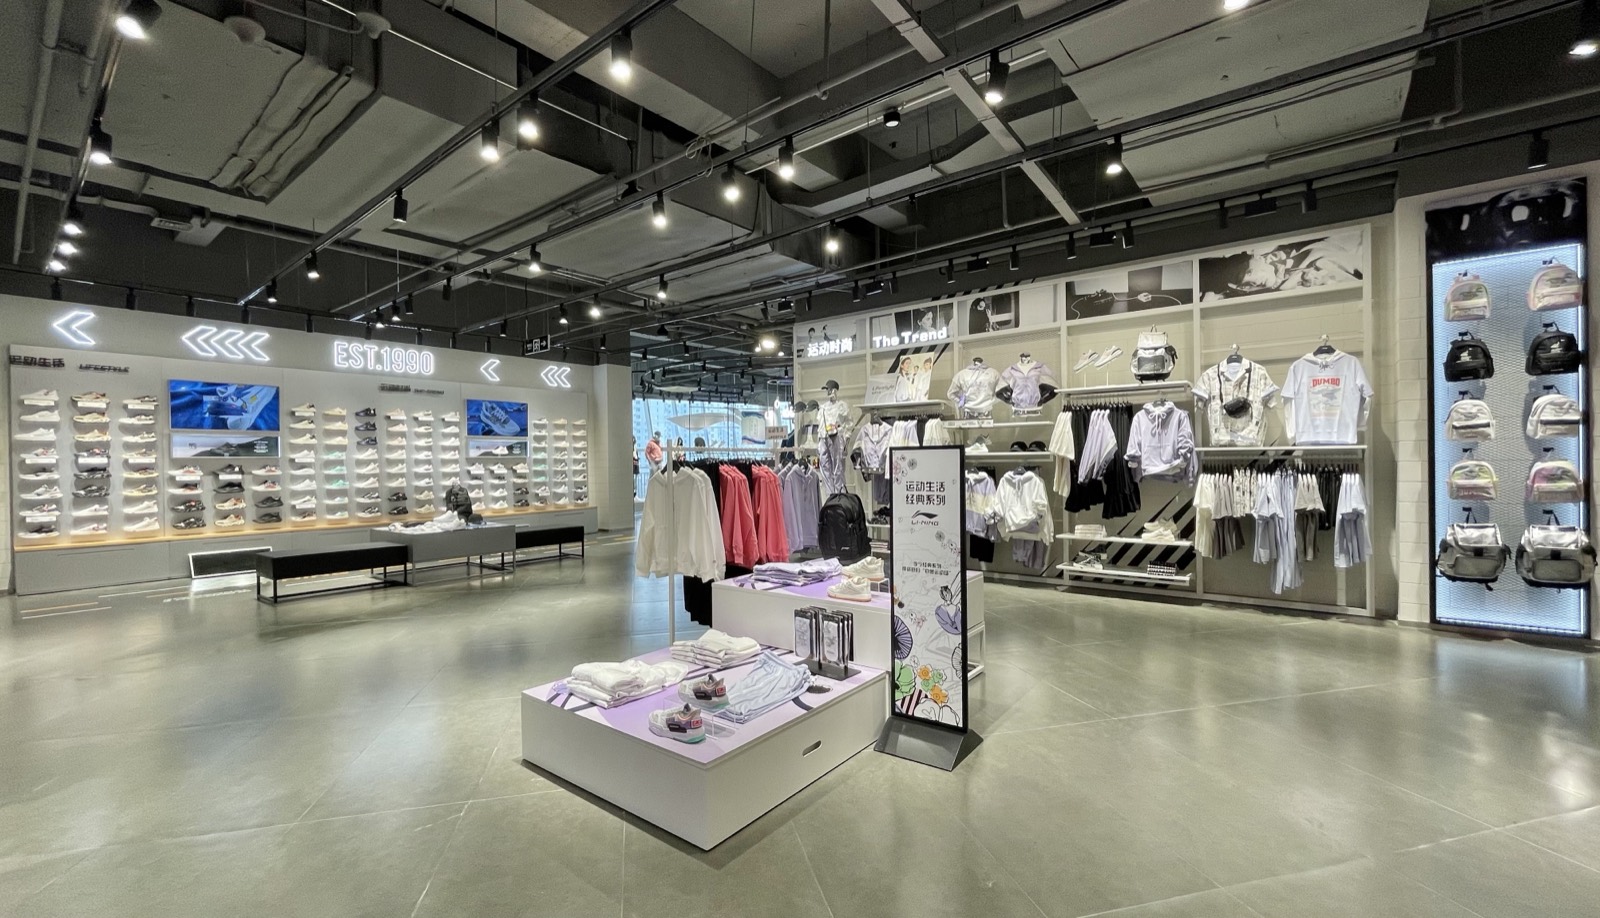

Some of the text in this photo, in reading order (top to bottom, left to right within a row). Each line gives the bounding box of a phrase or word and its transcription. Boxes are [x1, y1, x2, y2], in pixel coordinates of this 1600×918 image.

[873, 327, 948, 349] The Trend
[807, 337, 854, 358] 运动时尚
[333, 340, 435, 376] EST.1990
[79, 364, 129, 373] LIFESTYLE
[1312, 377, 1340, 387] DUMBO
[905, 480, 946, 493] 运动生活
[905, 494, 946, 506] 经典系列
